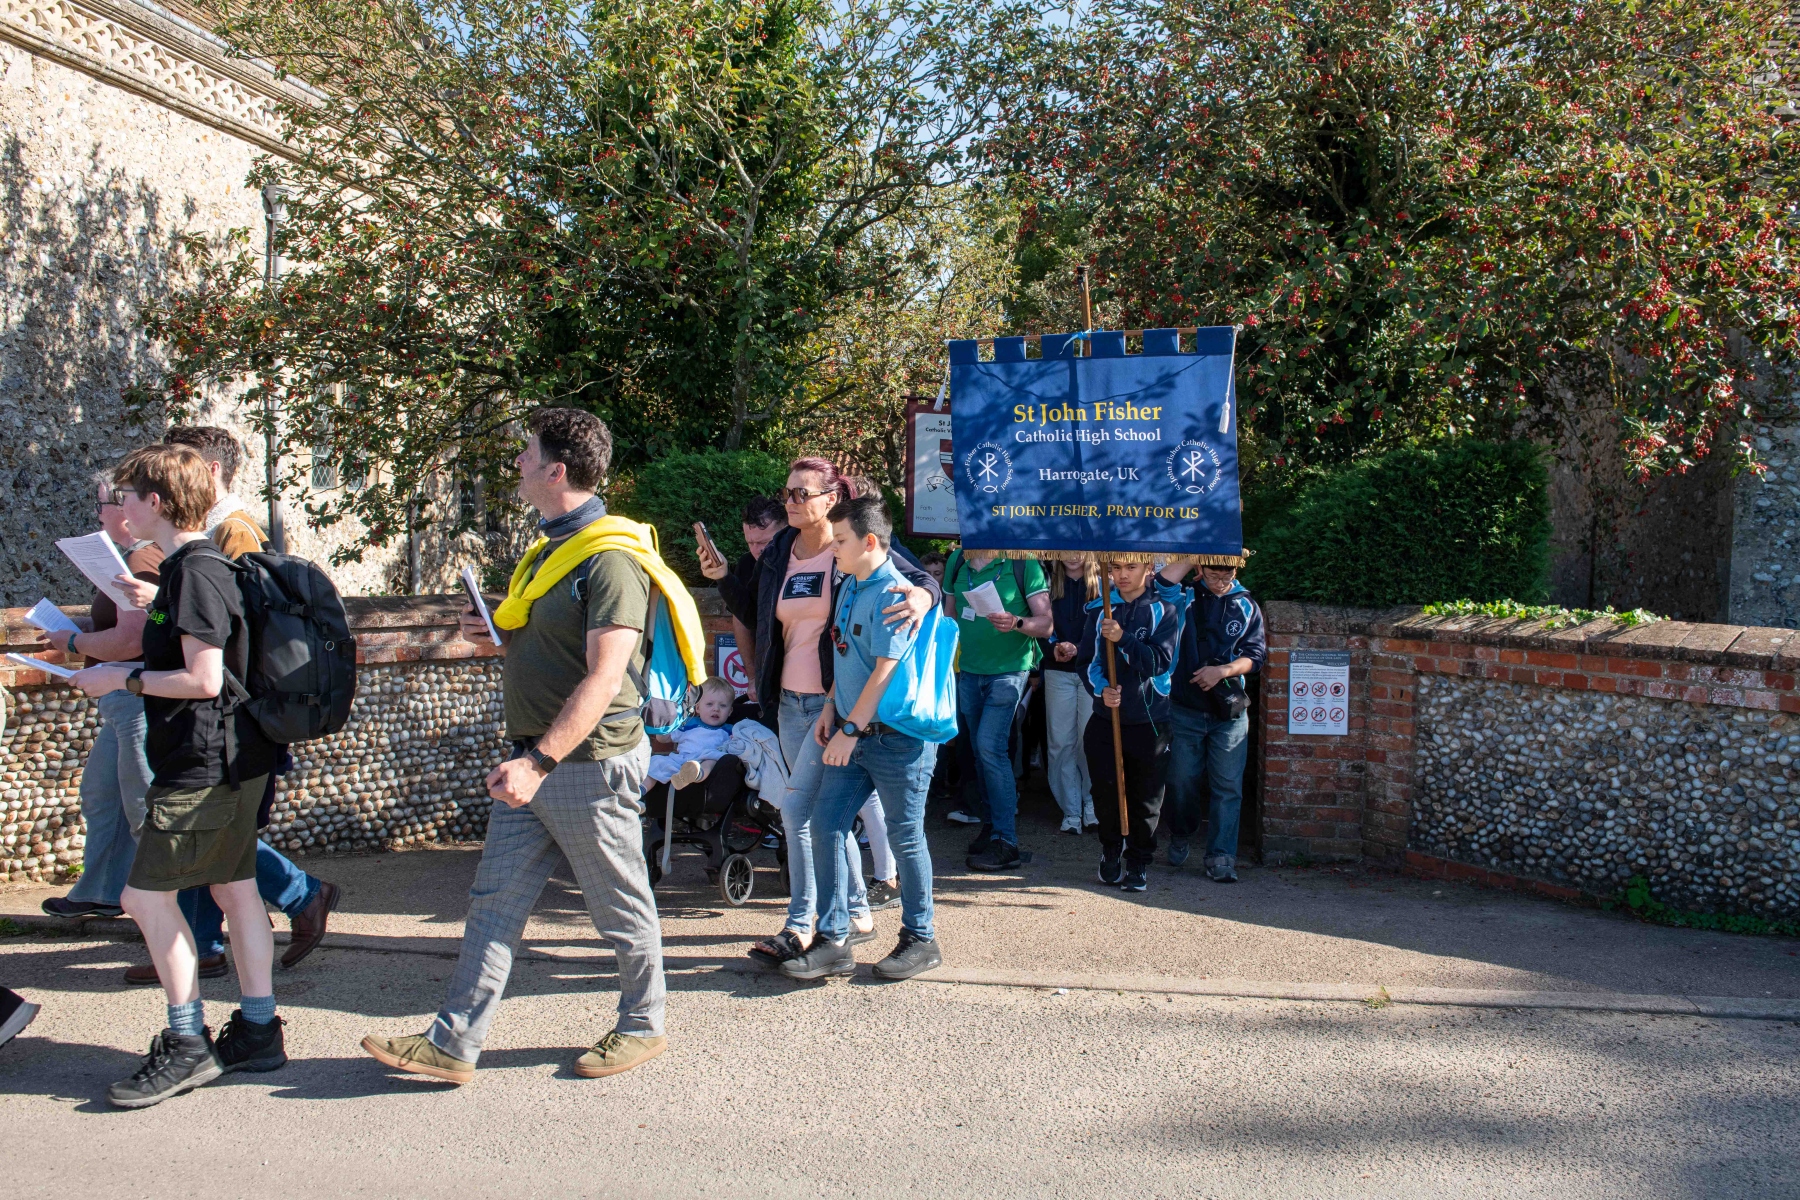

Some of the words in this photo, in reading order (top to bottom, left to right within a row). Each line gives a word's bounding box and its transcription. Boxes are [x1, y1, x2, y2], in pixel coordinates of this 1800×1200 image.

[1013, 404, 1035, 423] St
[1039, 402, 1088, 427] John
[1093, 401, 1162, 421] Fisher
[976, 441, 1003, 452] Catholic
[1015, 429, 1073, 443] Catholic
[1075, 429, 1111, 446] High
[1114, 428, 1162, 441] School
[1181, 439, 1210, 451] Catholic
[964, 447, 978, 467] Fisher
[1001, 449, 1013, 468] High
[1165, 444, 1181, 465] Fisher
[1208, 448, 1222, 467] High
[966, 467, 976, 484] John
[1000, 468, 1014, 491] School
[1038, 468, 1113, 484] Harrogate,
[1117, 467, 1140, 481] UK
[1166, 465, 1178, 484] John
[1207, 468, 1222, 491] School
[1174, 482, 1182, 491] St
[991, 505, 1006, 517] ST
[1009, 505, 1047, 519] JOHN
[1050, 504, 1102, 519] FISHER,
[1106, 505, 1142, 518] PRAY
[1144, 506, 1175, 519] FOR
[1179, 507, 1200, 519] US
